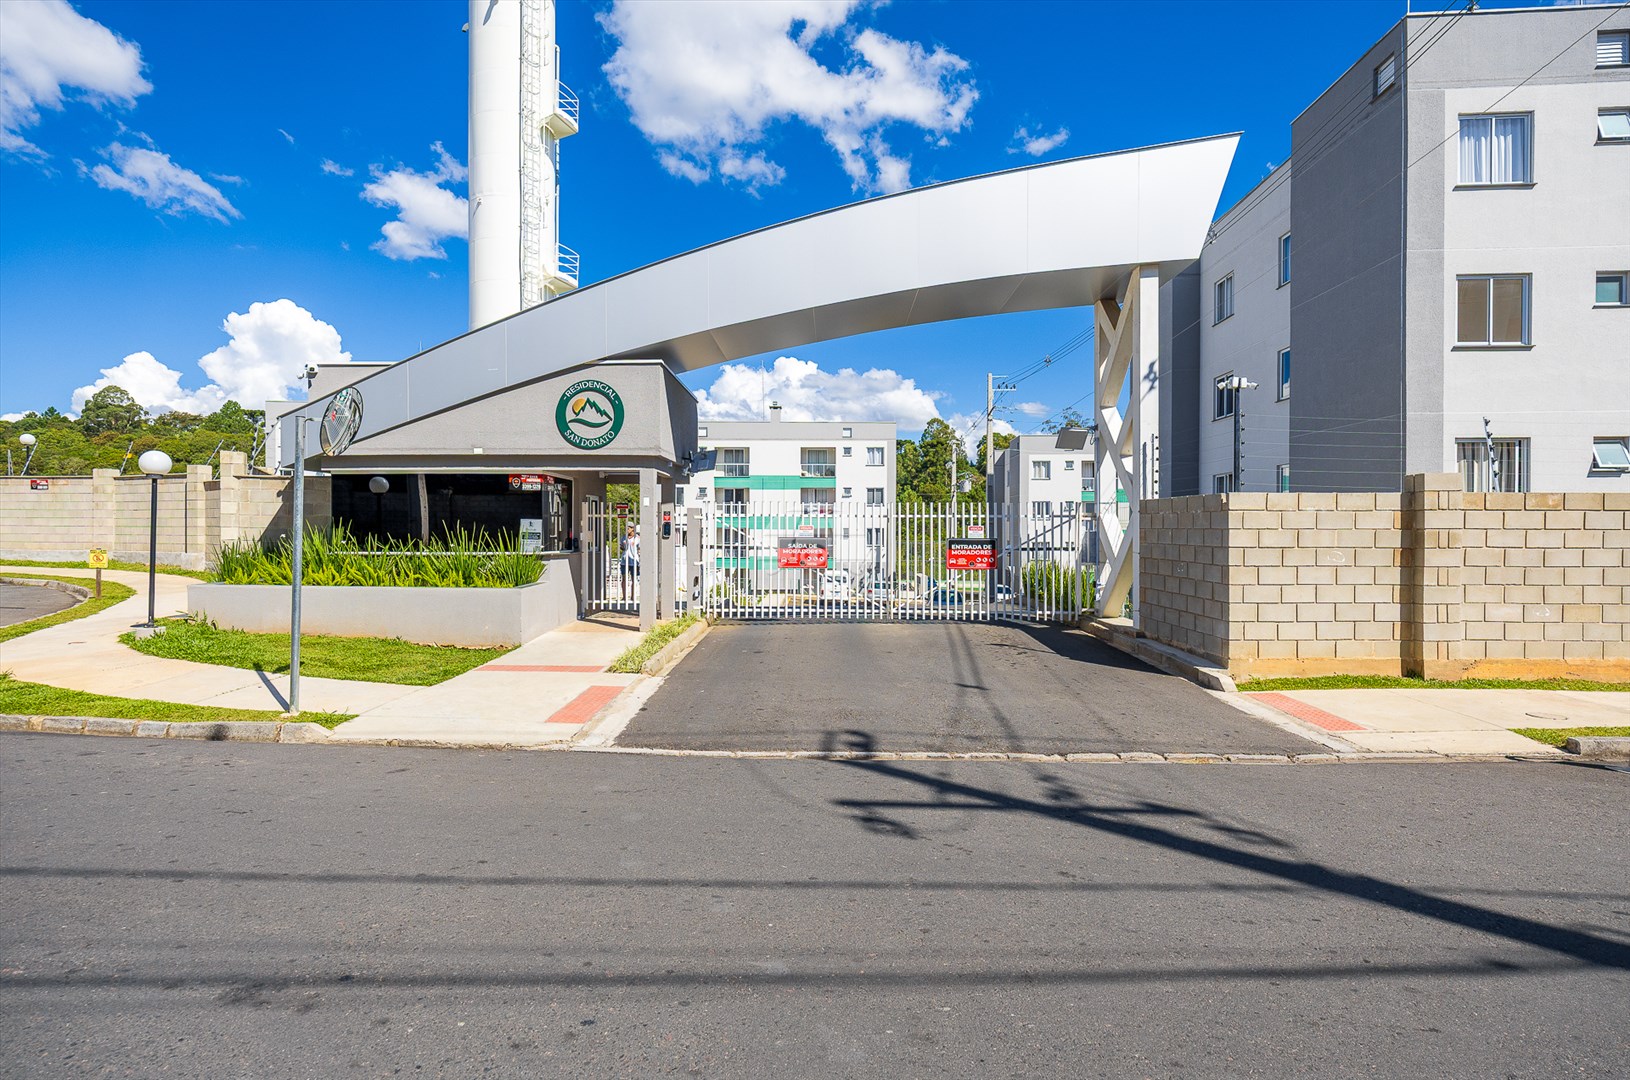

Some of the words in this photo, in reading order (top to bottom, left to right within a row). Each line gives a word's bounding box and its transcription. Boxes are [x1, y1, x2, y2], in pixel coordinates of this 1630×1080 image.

[565, 381, 616, 400] RESIDENCIAL
[564, 429, 580, 443] SAN
[580, 430, 615, 447] DONATO
